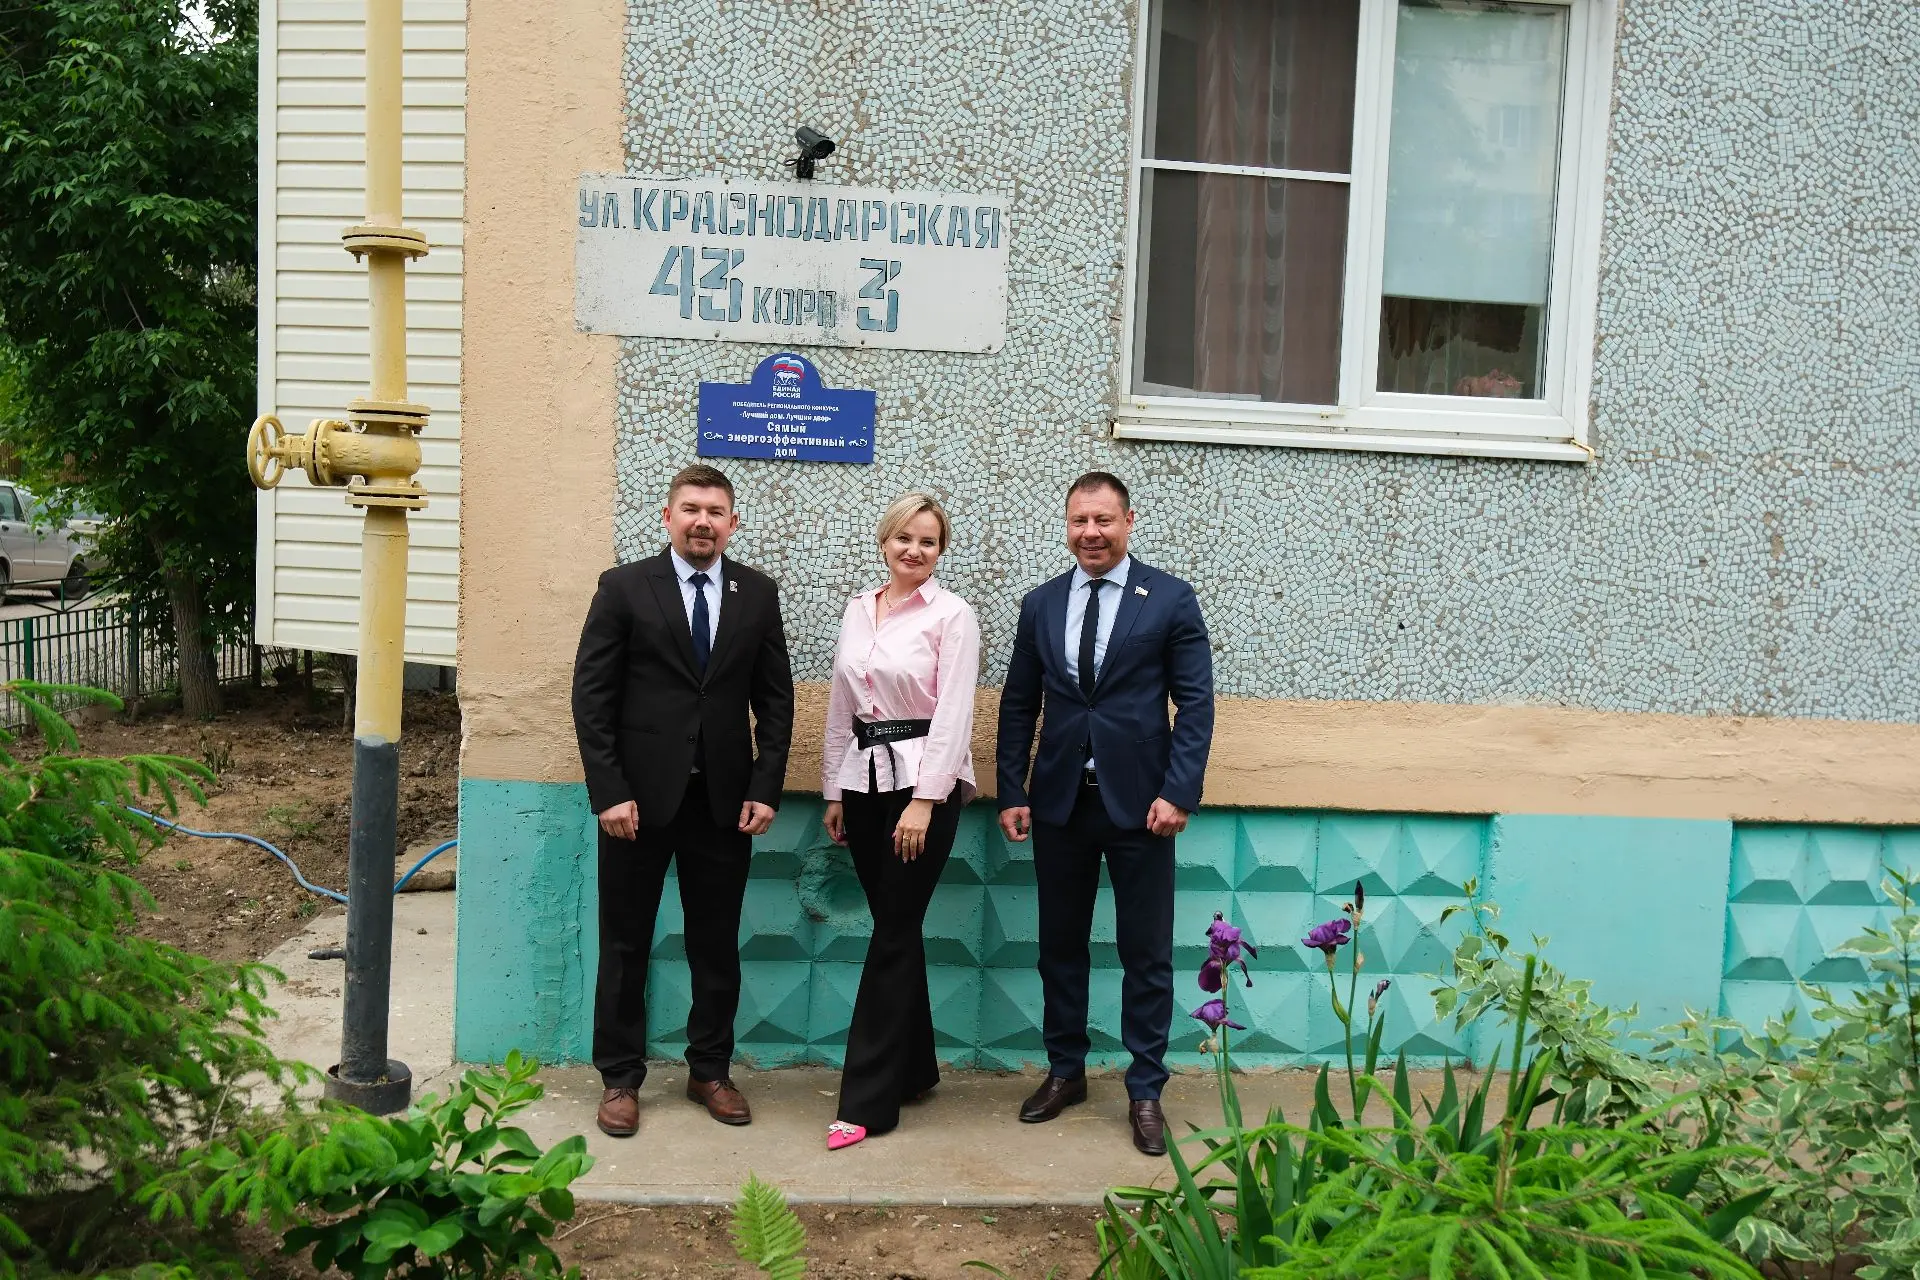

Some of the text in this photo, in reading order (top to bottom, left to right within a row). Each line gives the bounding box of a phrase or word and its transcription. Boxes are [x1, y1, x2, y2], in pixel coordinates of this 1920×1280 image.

[633, 187, 1000, 248] КРАСНОДАРСКАЯ
[648, 245, 744, 322] 43
[856, 257, 902, 332] 3
[786, 413, 812, 421] Лучший
[767, 421, 807, 433] Самый
[727, 433, 845, 447] энергоэффективный
[775, 448, 797, 457] дом
